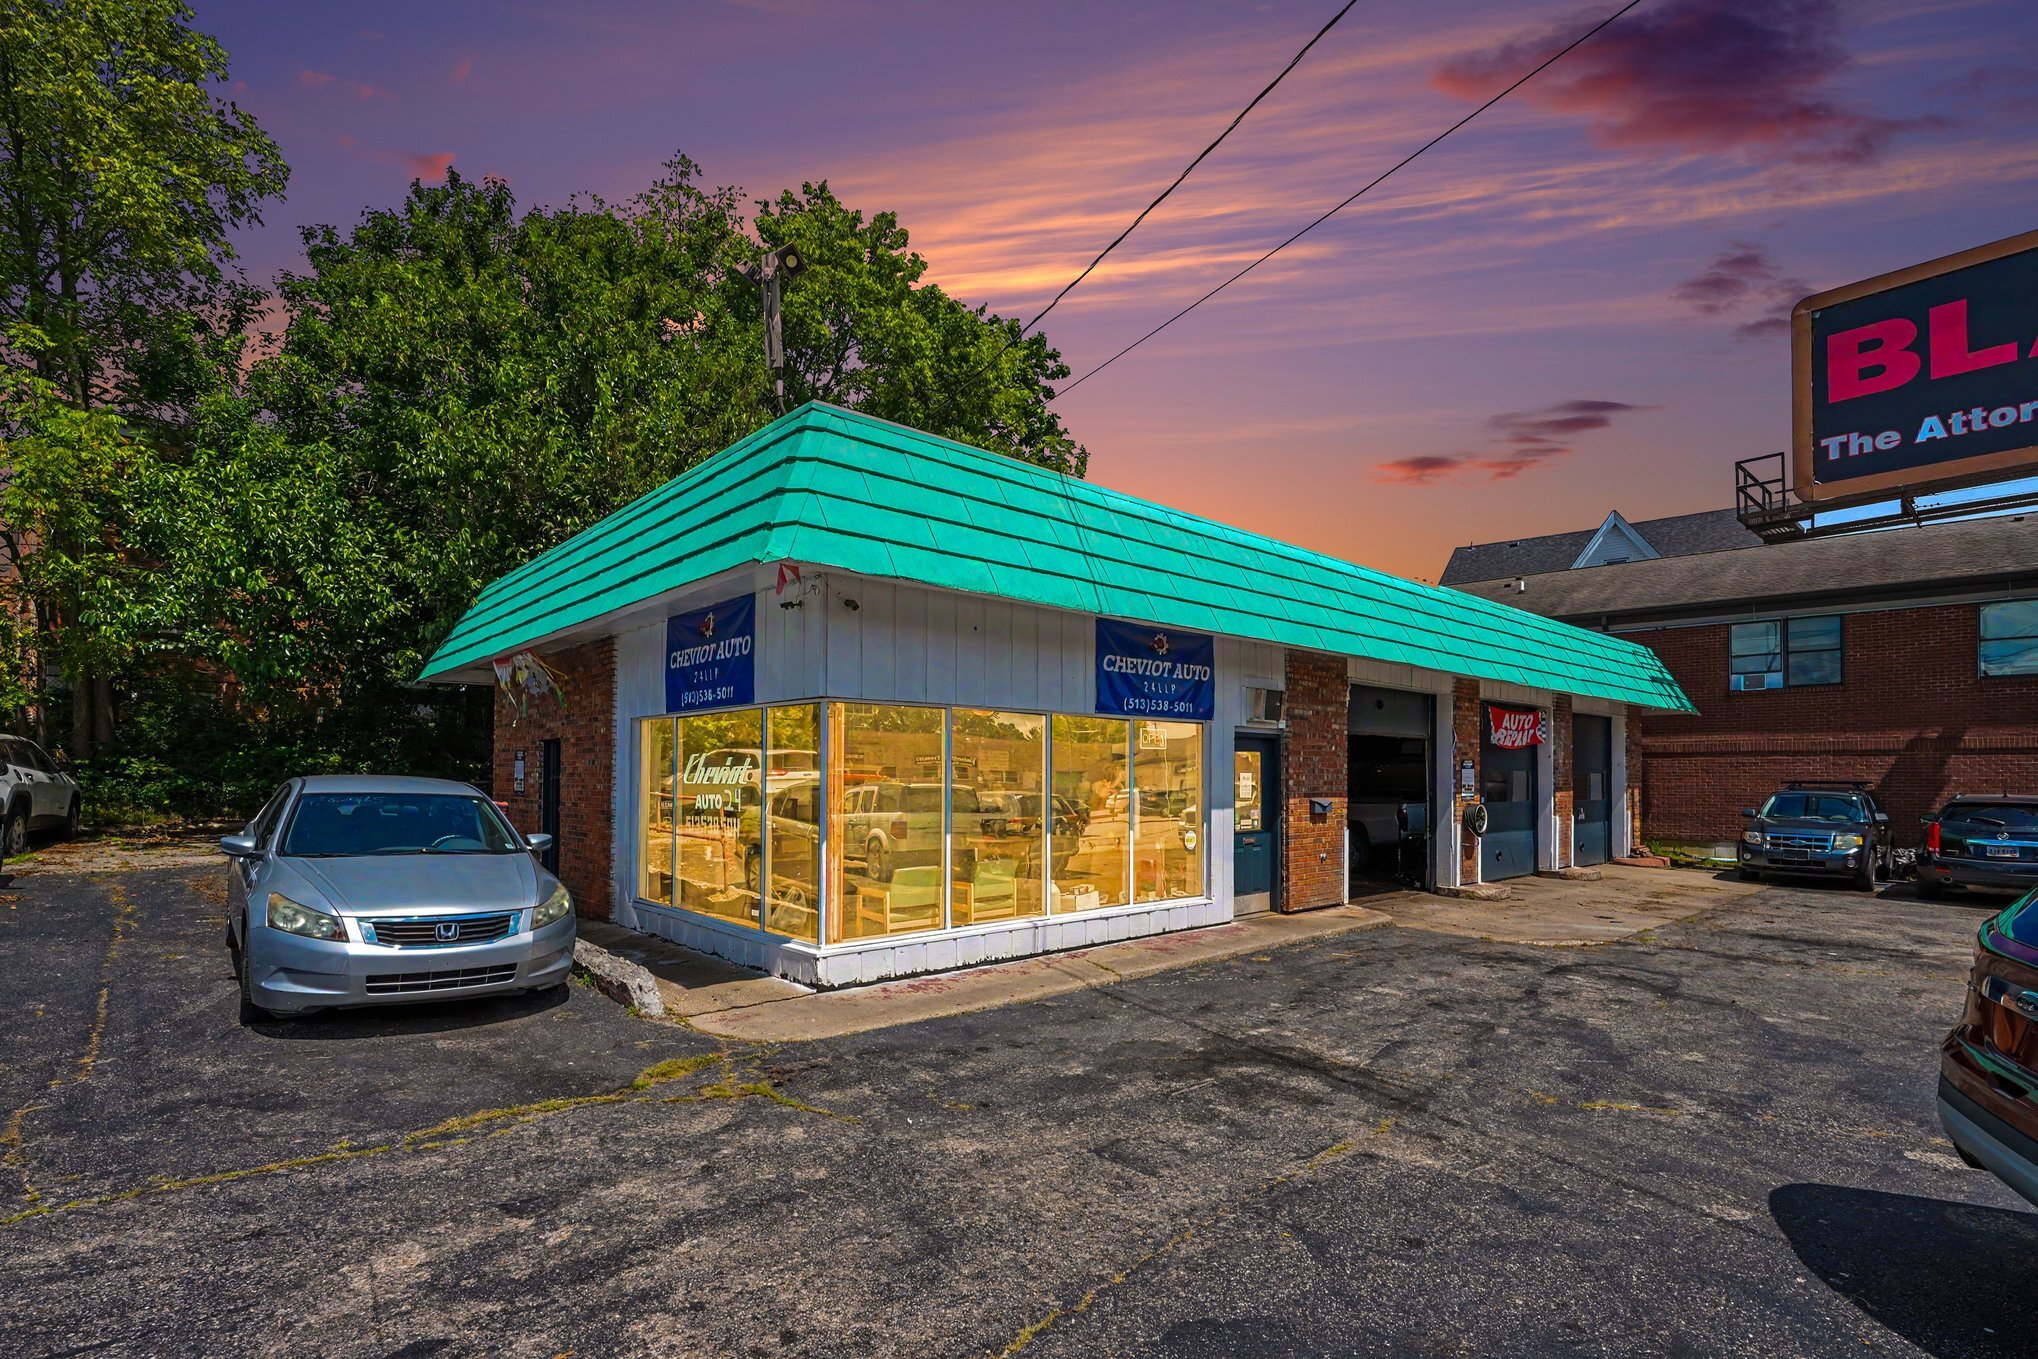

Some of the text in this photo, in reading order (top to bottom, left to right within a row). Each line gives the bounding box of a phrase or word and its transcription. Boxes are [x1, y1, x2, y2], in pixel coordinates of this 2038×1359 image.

[1828, 299, 2038, 404] BL
[1821, 430, 1901, 460] The
[670, 635, 751, 669] CHEVIOT AUTO
[1103, 655, 1210, 681] CHEVIOT AUTO
[1124, 697, 1193, 713] (513)538-5011
[1502, 713, 1534, 730] AUTO
[683, 753, 752, 784] Cheviot
[695, 788, 741, 812] AUTO 24
